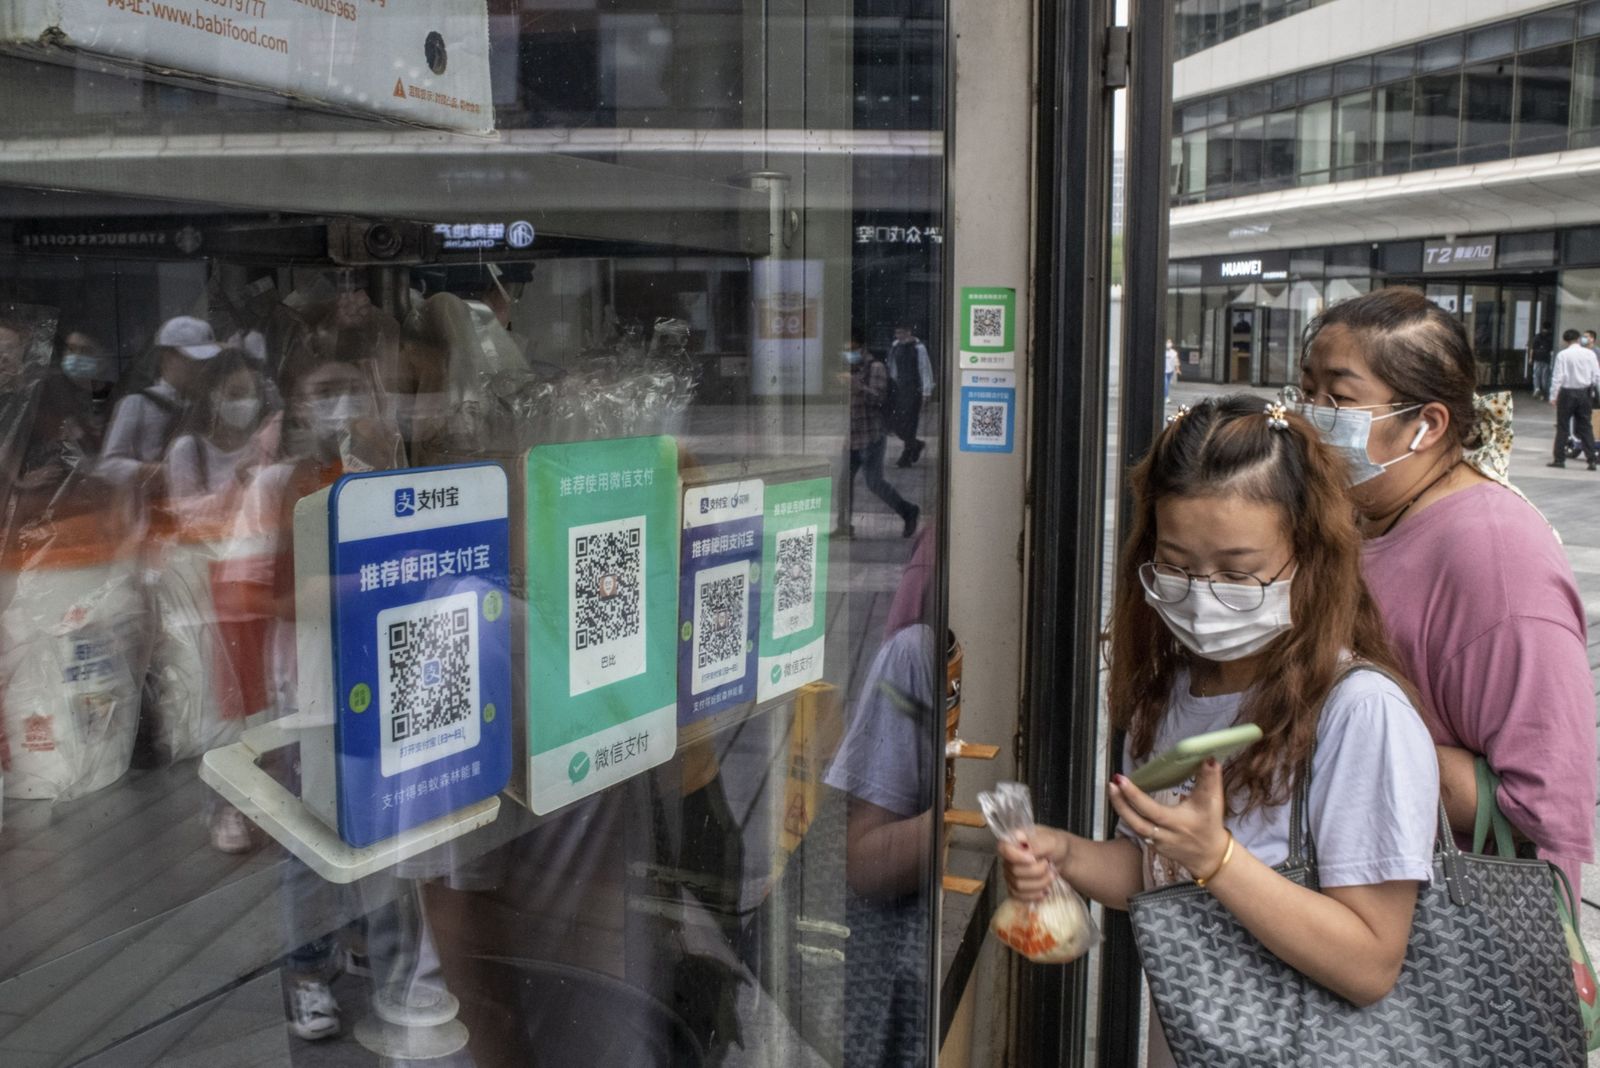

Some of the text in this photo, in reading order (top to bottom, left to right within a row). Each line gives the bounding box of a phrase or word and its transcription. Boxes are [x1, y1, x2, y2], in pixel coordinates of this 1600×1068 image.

[1221, 259, 1262, 277] HUAWEI
[1426, 247, 1453, 264] T2
[559, 467, 654, 497] 推荐使用微信支付
[417, 486, 459, 512] 支付宝
[691, 530, 755, 559] 推荐使用支付宝
[359, 543, 491, 593] 推荐使用支付宝
[594, 730, 649, 771] 微信支付
[381, 760, 481, 811] 支付得蚂蚁森林能量
